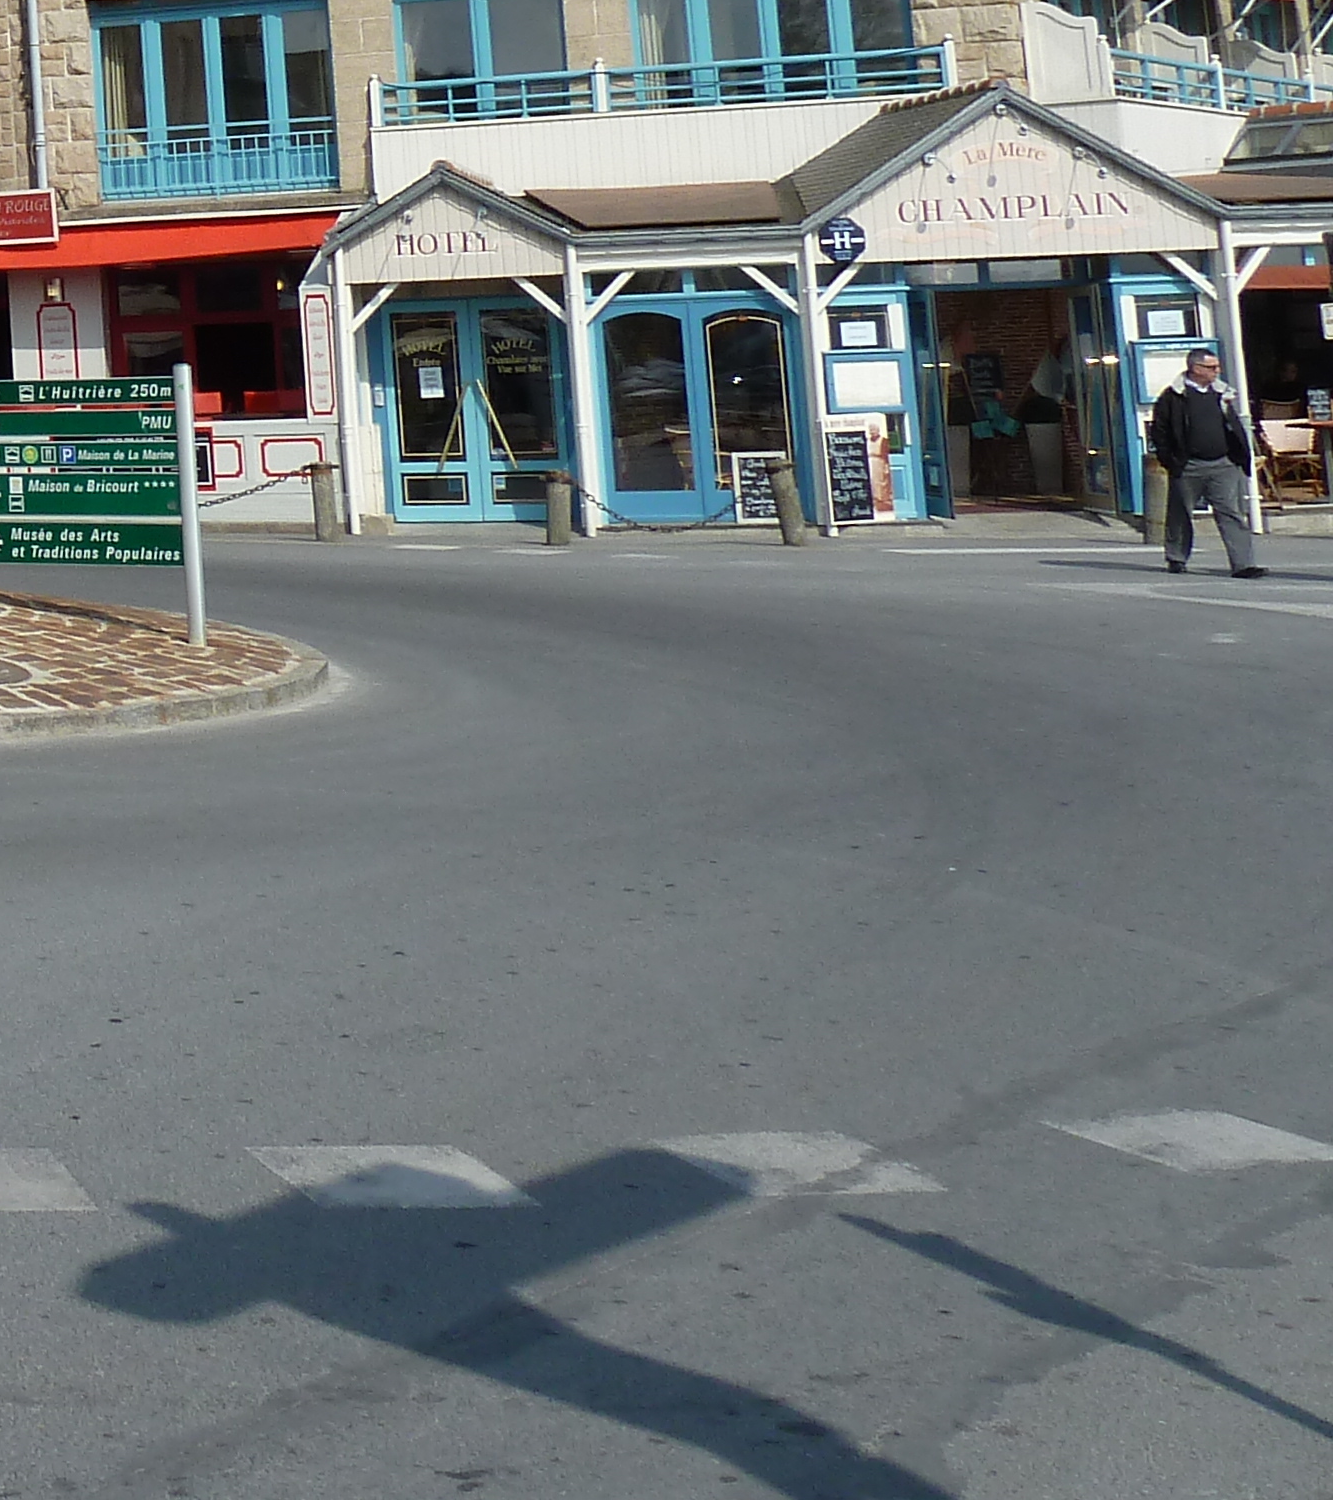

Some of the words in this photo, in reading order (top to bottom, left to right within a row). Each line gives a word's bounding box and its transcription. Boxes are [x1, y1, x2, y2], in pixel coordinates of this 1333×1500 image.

[962, 149, 988, 165] La
[5, 198, 50, 214] ROUGE
[897, 190, 1129, 224] CHAMPLAIN
[394, 231, 498, 256] HOTEL
[833, 231, 852, 249] H
[490, 337, 536, 355] HOTEL
[38, 385, 122, 400] L'Huîtrière
[129, 383, 172, 398] 250m
[141, 415, 172, 430] PMU
[77, 448, 110, 460] Maison
[113, 449, 125, 460] de
[128, 448, 139, 460] La
[142, 448, 175, 460] Marine
[28, 479, 70, 492] Maison
[86, 479, 139, 493] Bricourt
[10, 527, 54, 542] Musée
[60, 528, 84, 542] des
[90, 528, 120, 542] Arts
[11, 546, 25, 558] et
[30, 545, 99, 560] Traditions
[105, 546, 181, 563] Populaires
